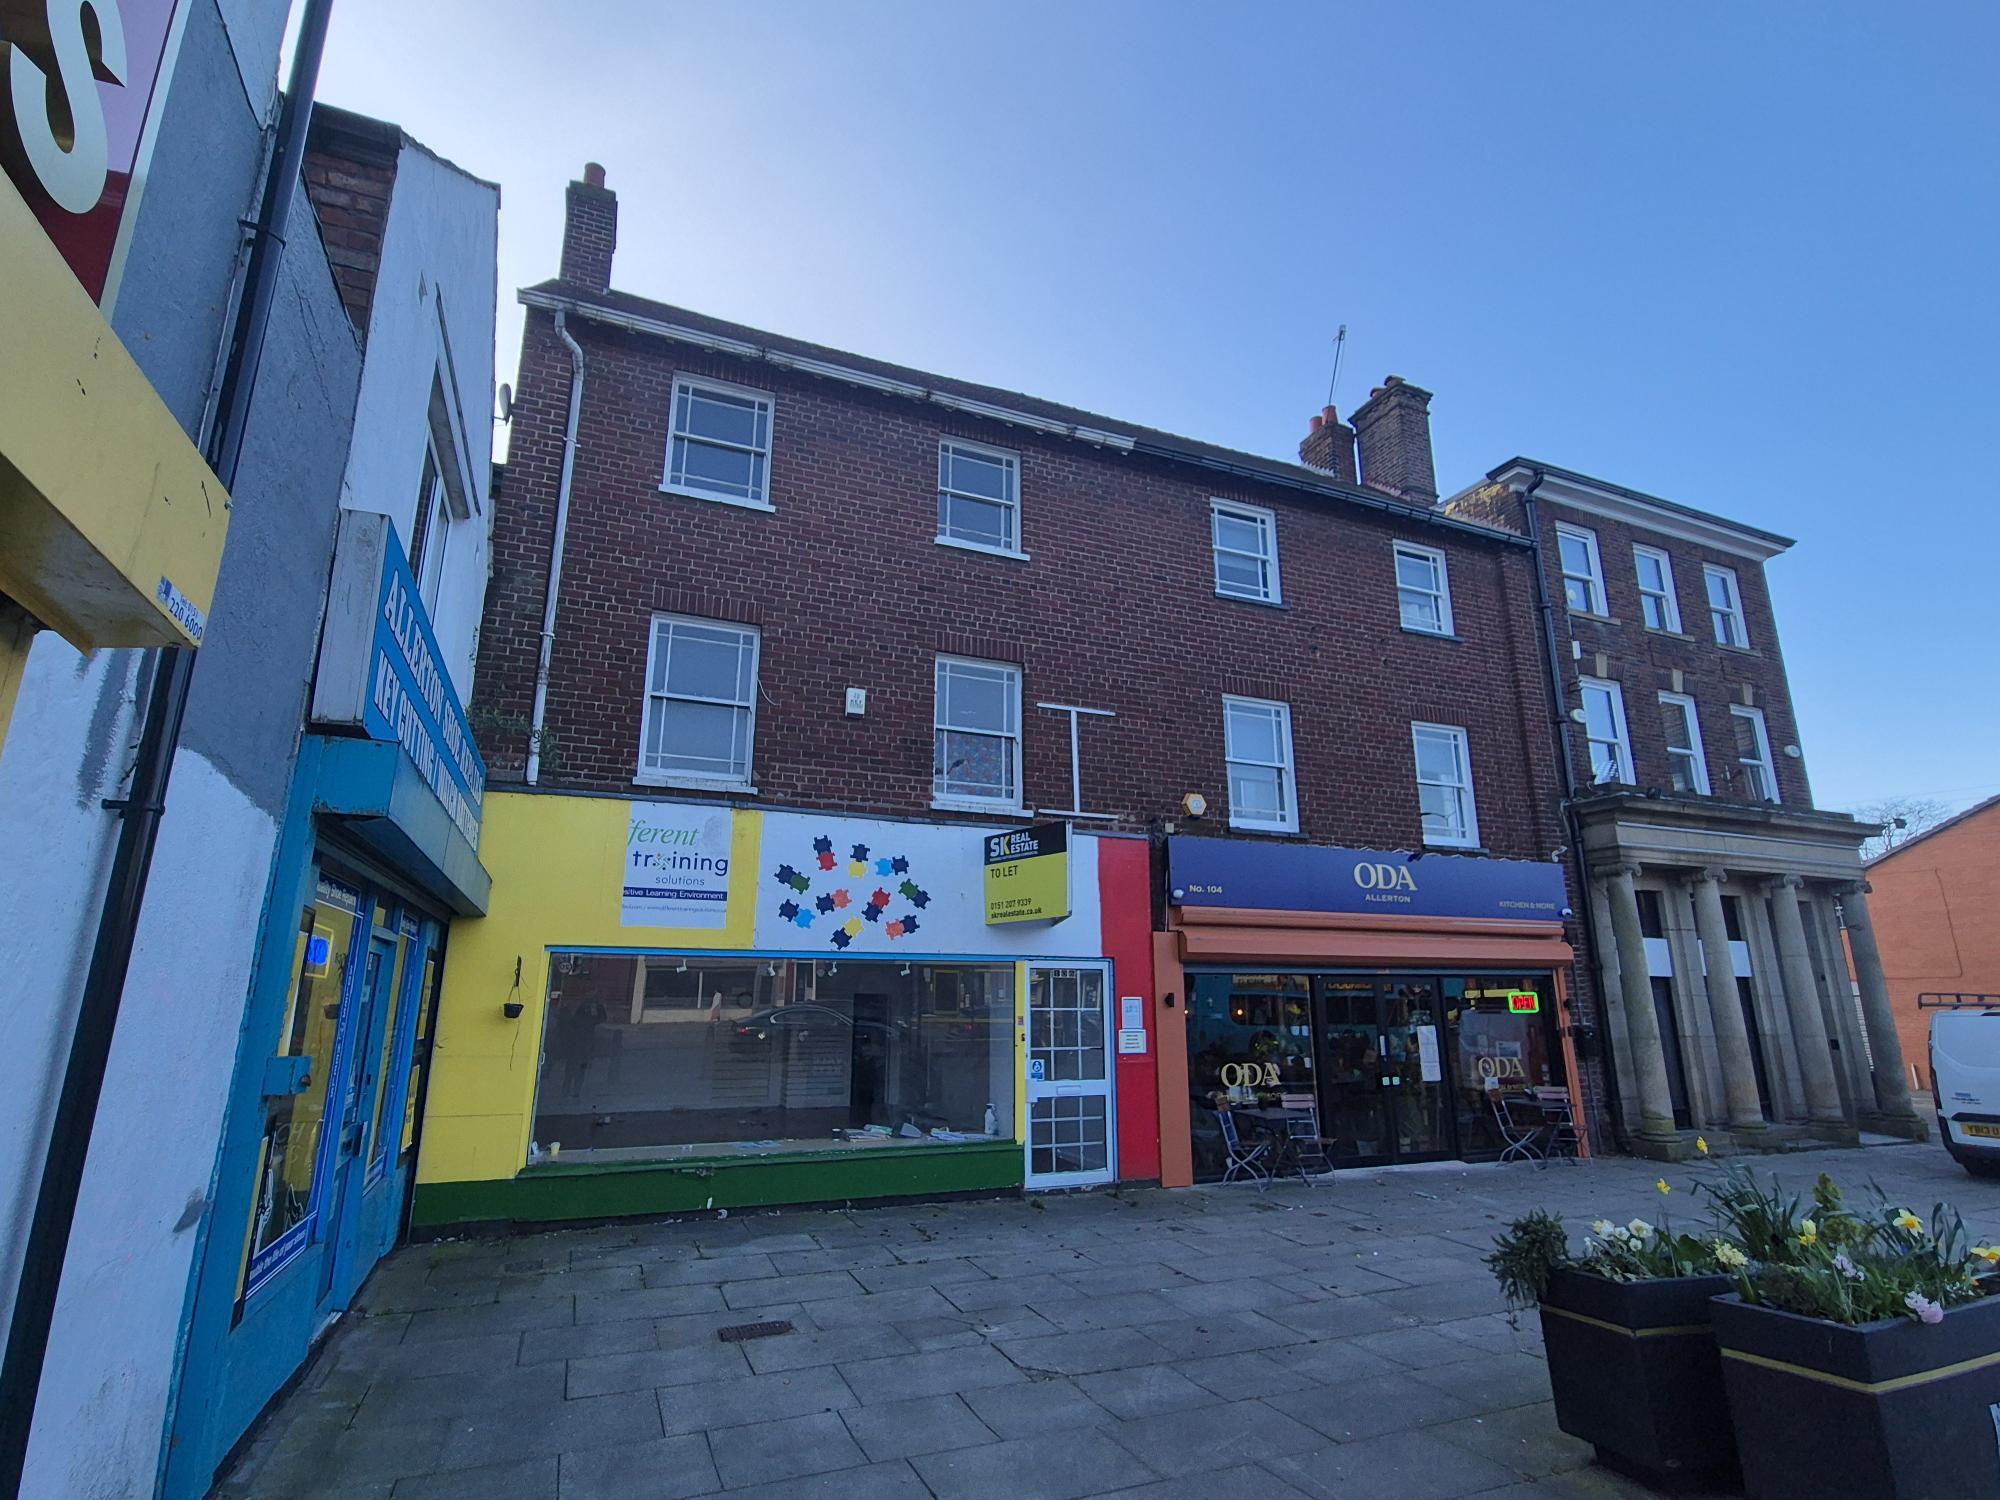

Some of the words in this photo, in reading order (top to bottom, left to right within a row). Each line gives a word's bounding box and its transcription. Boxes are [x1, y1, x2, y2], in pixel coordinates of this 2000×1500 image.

[169, 598, 184, 622] 220
[184, 614, 203, 640] 6000
[384, 569, 445, 727] ALLERTON
[442, 697, 462, 764] SHOE
[460, 737, 482, 806] REPAIRS
[373, 647, 400, 729] KEY
[396, 689, 435, 784] CUTTING
[437, 758, 458, 821] WATCH
[628, 818, 700, 847] ferent
[1011, 832, 1030, 844] REAL
[990, 835, 1010, 857] SK
[1011, 840, 1039, 853] ESTATE
[655, 874, 705, 887] solutions
[990, 868, 1001, 879] TO
[1003, 865, 1018, 877] LET
[1353, 862, 1418, 891] ODA
[646, 888, 677, 899] Learning
[679, 890, 724, 900] Environment
[1189, 884, 1204, 893] No.
[1207, 885, 1223, 894] 104
[1365, 893, 1411, 903] ALLERTON
[991, 901, 1004, 911] 0151
[1511, 995, 1537, 1010] OPEN
[1220, 1061, 1281, 1089] ODA
[1478, 1056, 1526, 1078] ODA
